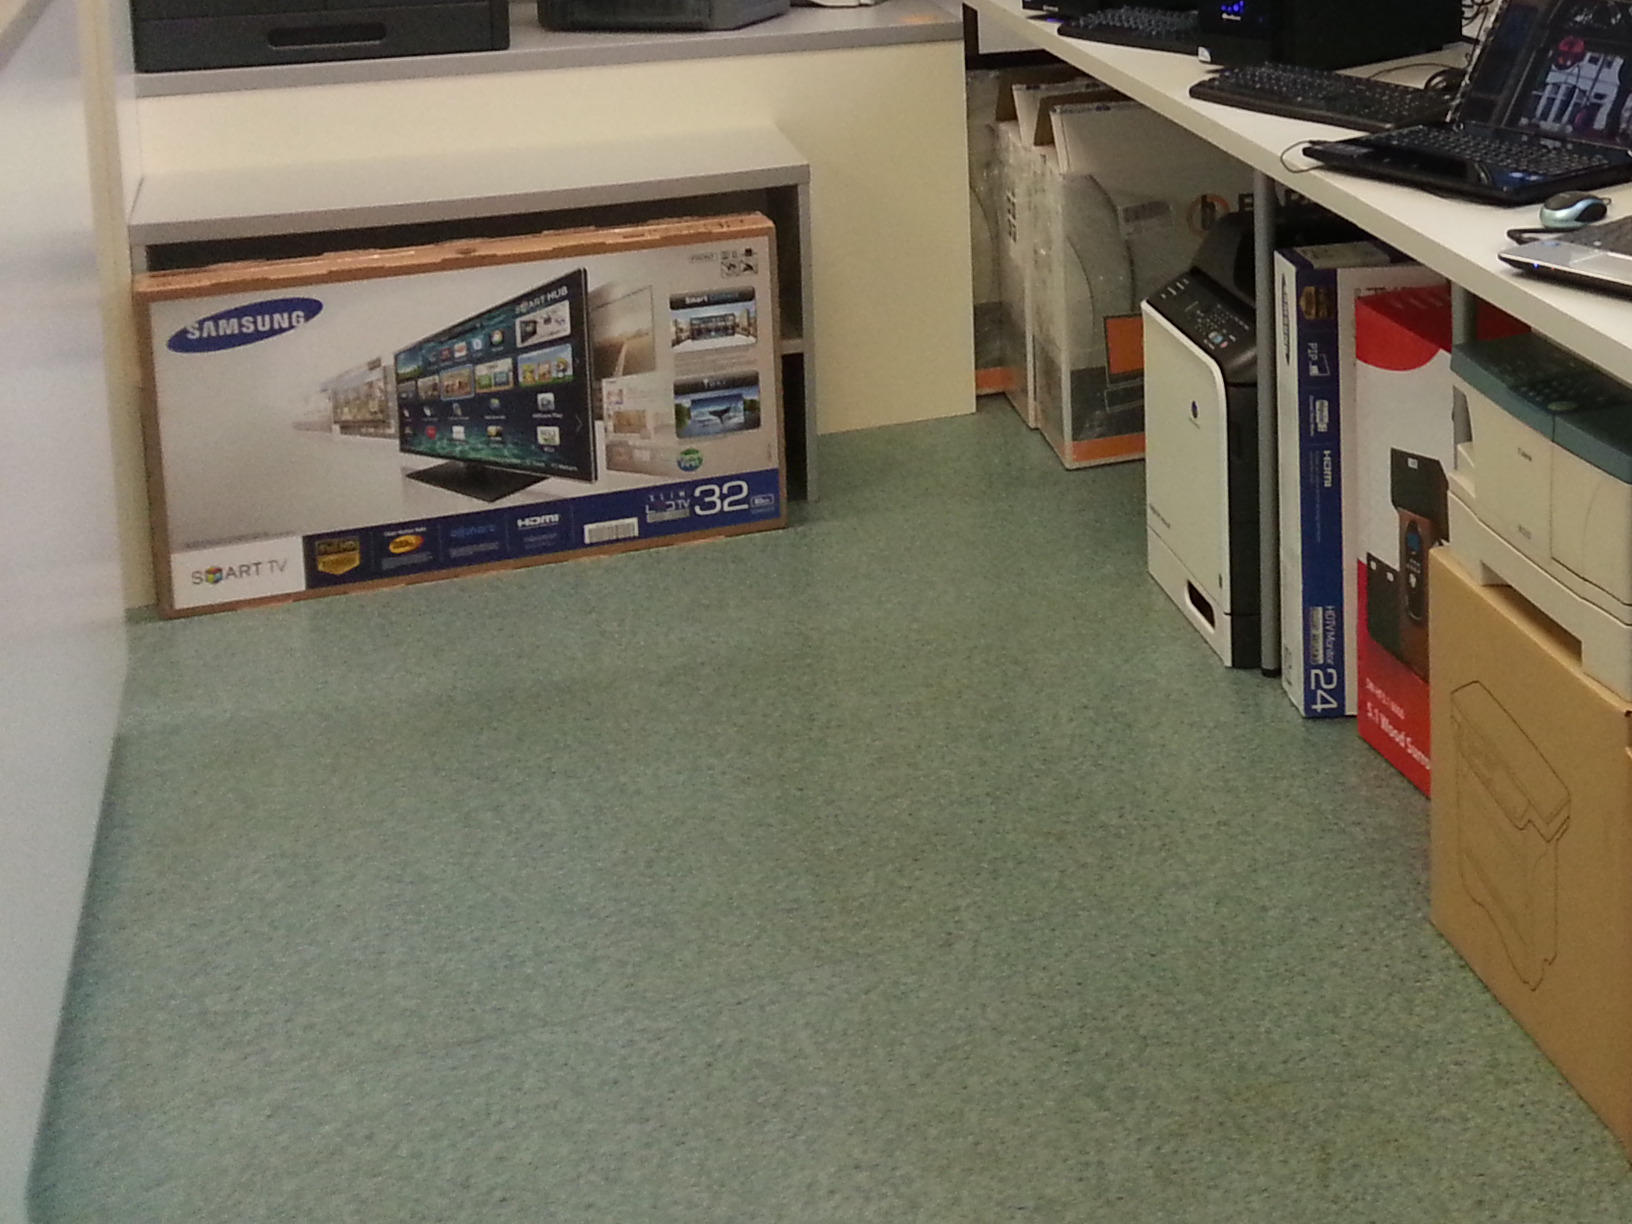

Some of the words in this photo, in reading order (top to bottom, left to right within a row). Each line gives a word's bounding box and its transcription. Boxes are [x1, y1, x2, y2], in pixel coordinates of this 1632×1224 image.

[546, 285, 569, 301] HUB
[185, 310, 306, 340] SAMSUNG
[677, 499, 690, 510] TV
[693, 480, 750, 516] 32
[517, 513, 560, 528] HDMI
[268, 558, 288, 574] TV
[1311, 668, 1339, 713] 24
